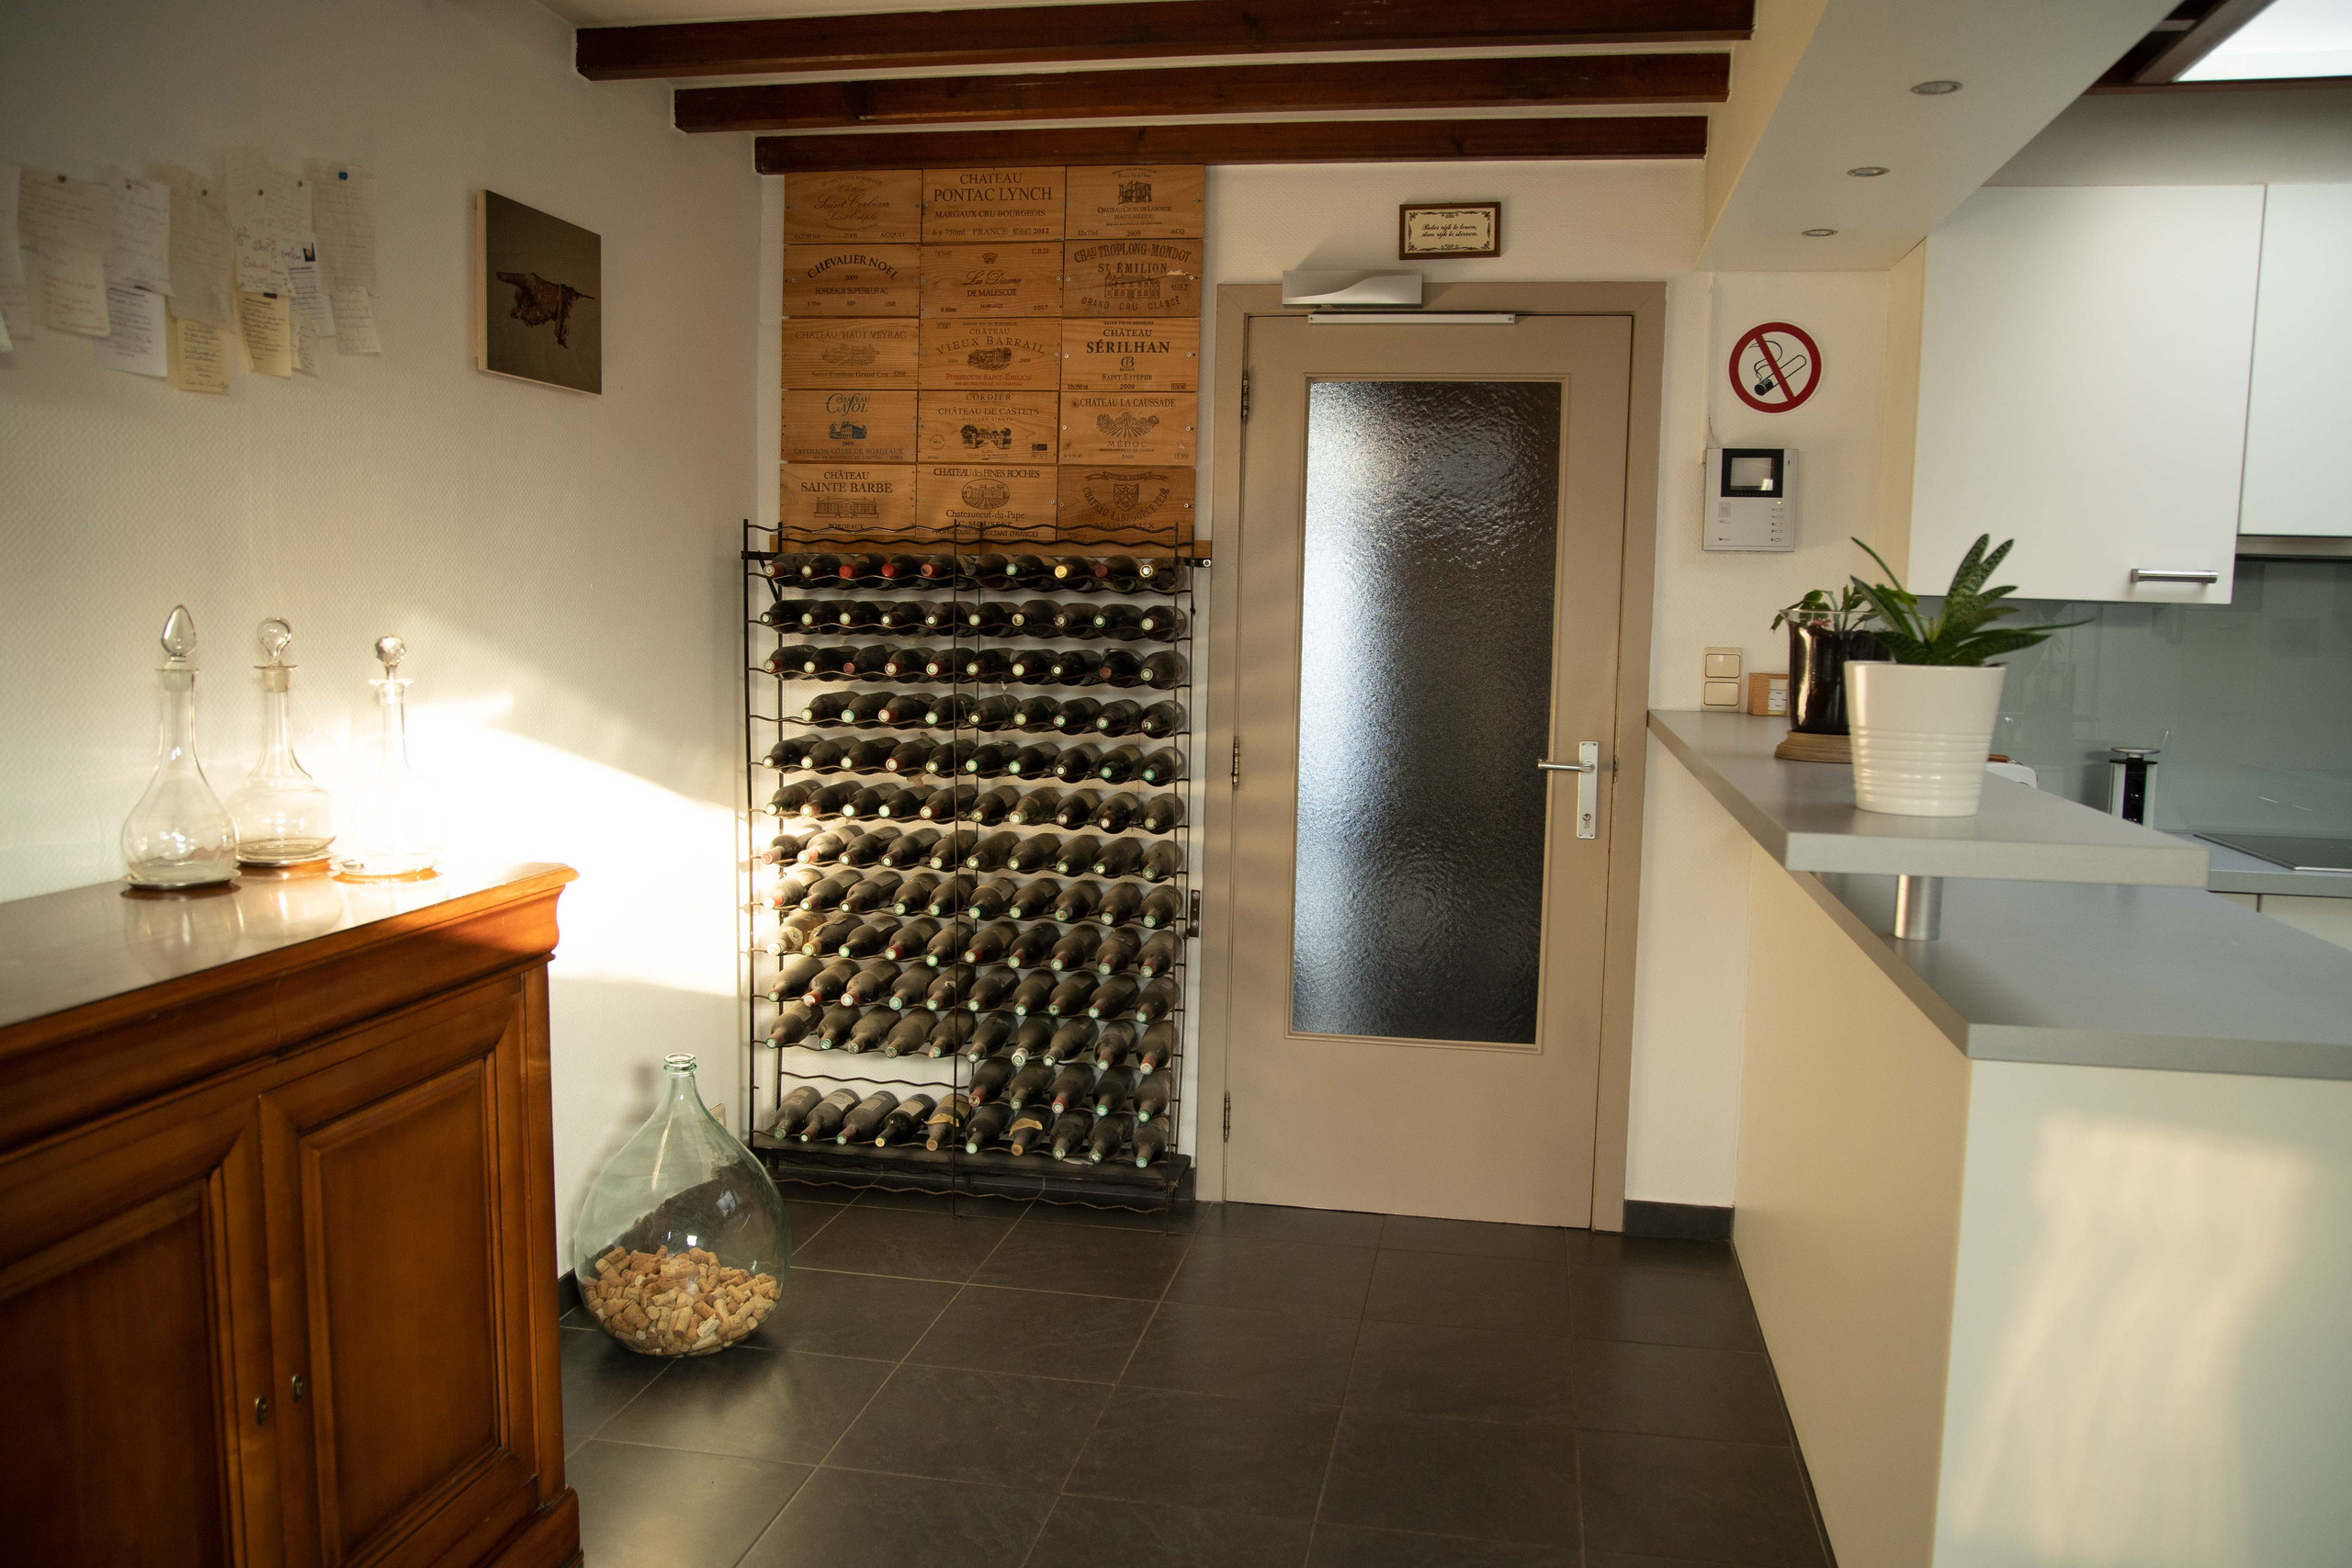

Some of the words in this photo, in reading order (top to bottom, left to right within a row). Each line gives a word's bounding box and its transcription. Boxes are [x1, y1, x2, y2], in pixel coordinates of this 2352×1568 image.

[960, 173, 1022, 185] CHATEAU
[933, 188, 995, 203] PONTAC
[999, 186, 1052, 201] LYNCH
[935, 210, 977, 219] MARGAUX
[998, 209, 1046, 217] BOURGEOIS
[808, 254, 866, 278] CHEVALIER
[869, 257, 898, 280] NOEL
[1116, 261, 1168, 273] ÉMILION
[962, 270, 983, 285] La
[984, 270, 1021, 285] Dame
[978, 288, 1017, 296] MALESCOT
[1081, 296, 1109, 310] GRAND
[1119, 303, 1138, 311] CRU
[795, 331, 837, 339] CHATEAU
[842, 331, 869, 339] HAUT
[870, 331, 907, 339] VEYRAC
[1103, 328, 1153, 337] CHÂTEAU
[935, 337, 979, 355] VIEUX
[986, 336, 1045, 354] BARRAIL
[1086, 339, 1170, 353] SÉRILHAN
[983, 372, 1031, 381] SAINT-ÉMILION
[1080, 398, 1118, 408] CHATEAU
[1121, 398, 1131, 407] LA
[1133, 398, 1176, 408] CAUSSADE
[1107, 439, 1148, 447] MÉDOC
[824, 470, 870, 480] CHÂTEAU
[1007, 470, 1040, 478] ROCHES
[801, 482, 846, 492] SAINTE
[850, 483, 893, 493] BARBE
[1083, 487, 1109, 516] CHATEAU
[946, 510, 1025, 521] Chateauneuf-du-Pape
